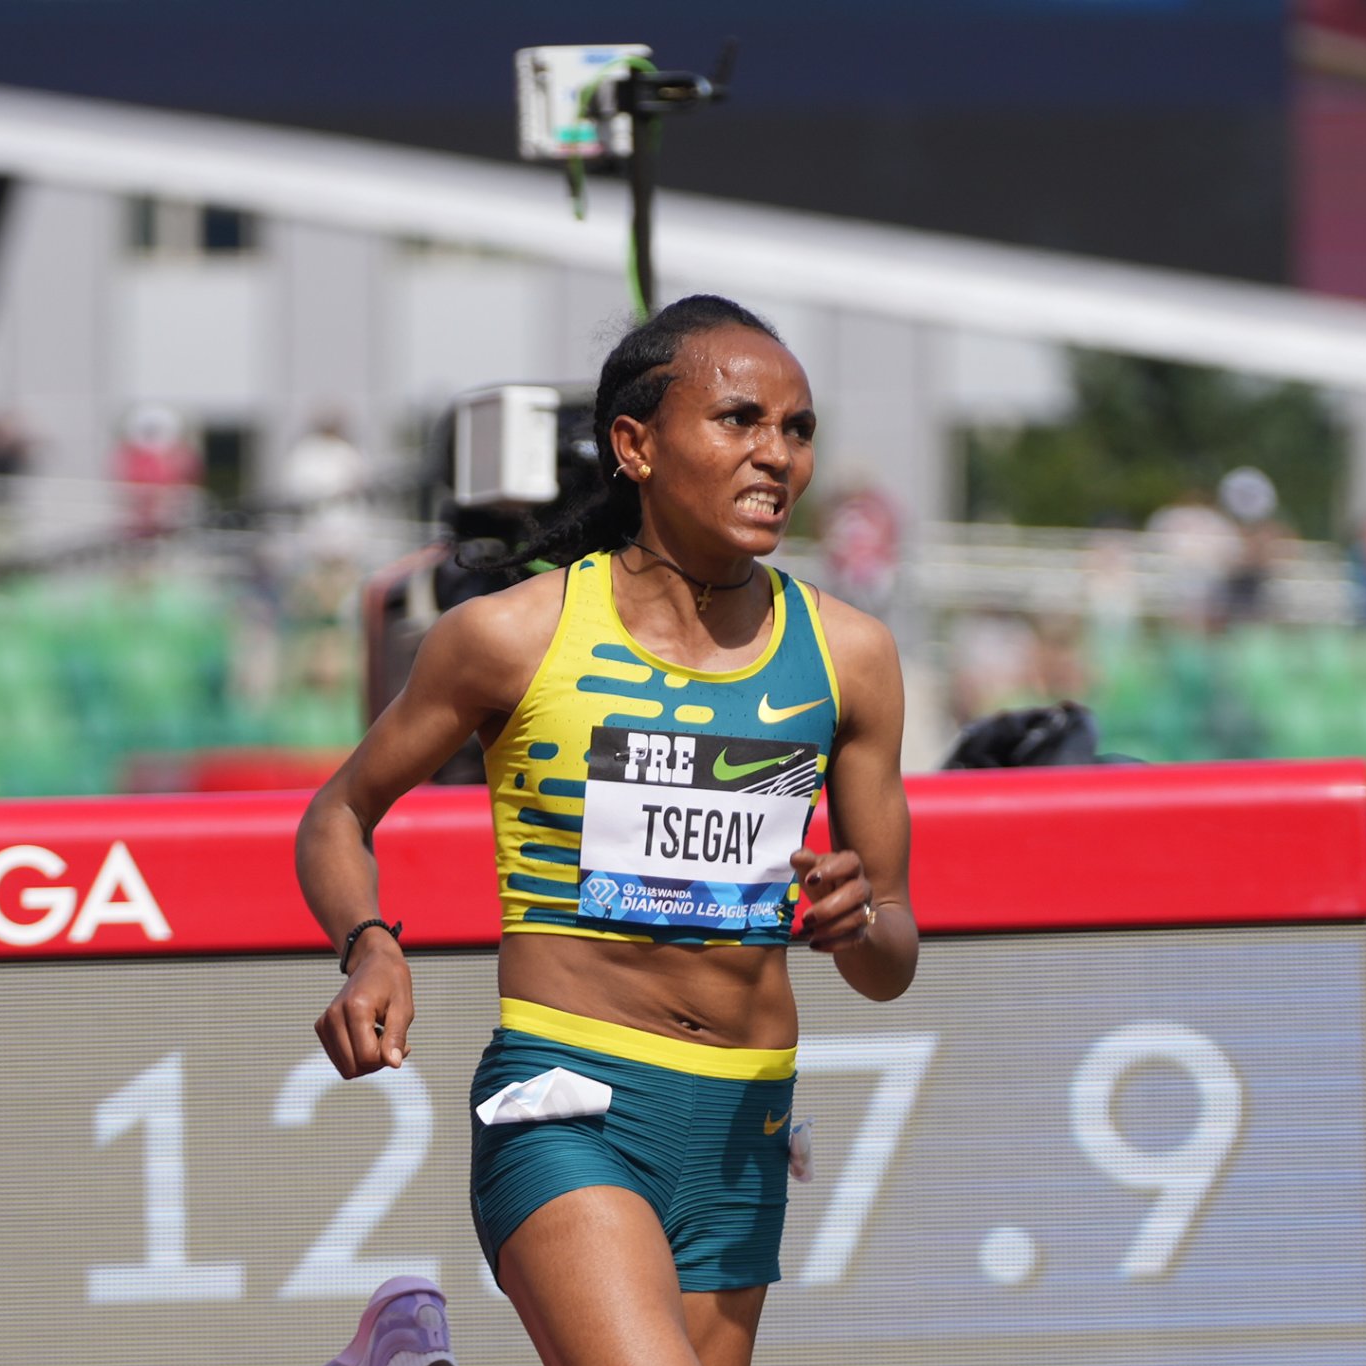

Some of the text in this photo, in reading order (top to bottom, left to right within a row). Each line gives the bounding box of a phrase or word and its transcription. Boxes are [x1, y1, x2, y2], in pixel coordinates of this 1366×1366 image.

[624, 731, 697, 786] PRE
[641, 803, 765, 865] TSEGAY
[620, 896, 695, 915] DIAMOND
[696, 903, 748, 919] LEAGUE
